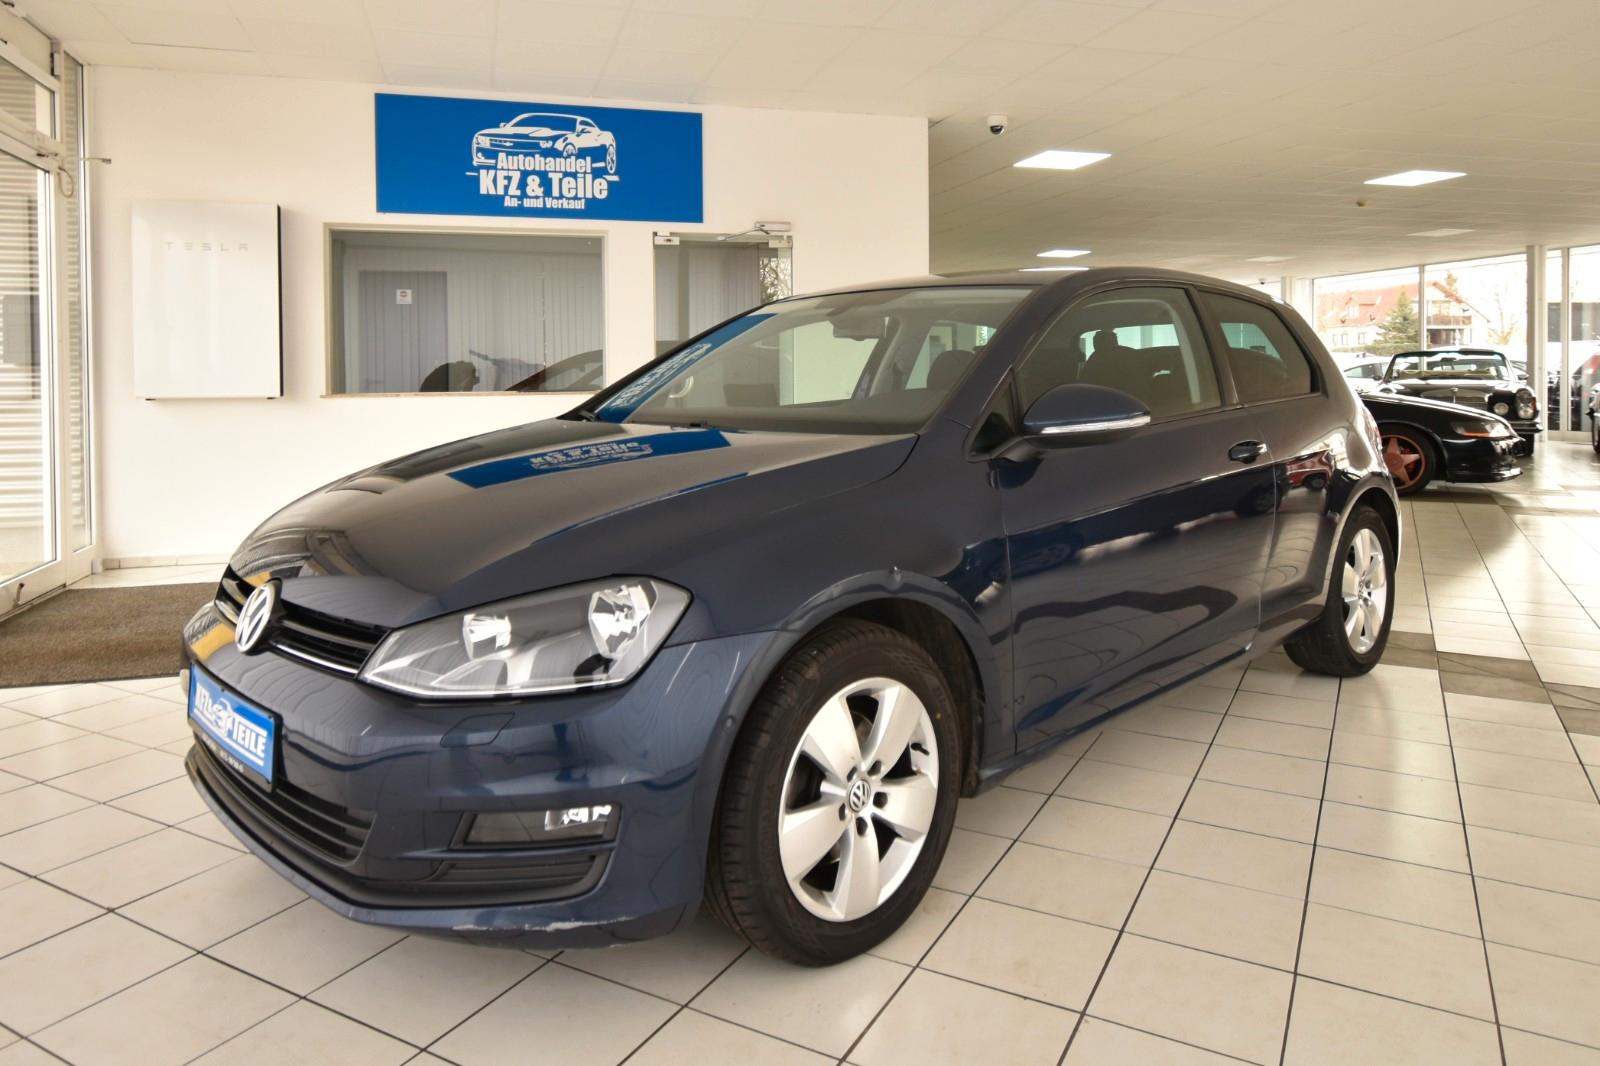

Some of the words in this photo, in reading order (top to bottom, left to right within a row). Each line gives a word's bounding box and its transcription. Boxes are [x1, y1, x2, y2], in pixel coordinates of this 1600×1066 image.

[497, 152, 591, 172] Autohandel
[479, 169, 521, 195] KFZ
[525, 174, 544, 197] &
[548, 172, 608, 199] Teile
[504, 195, 521, 208] An-
[523, 197, 544, 208] und
[545, 197, 586, 210] Verkauf
[163, 241, 250, 252] TESLA
